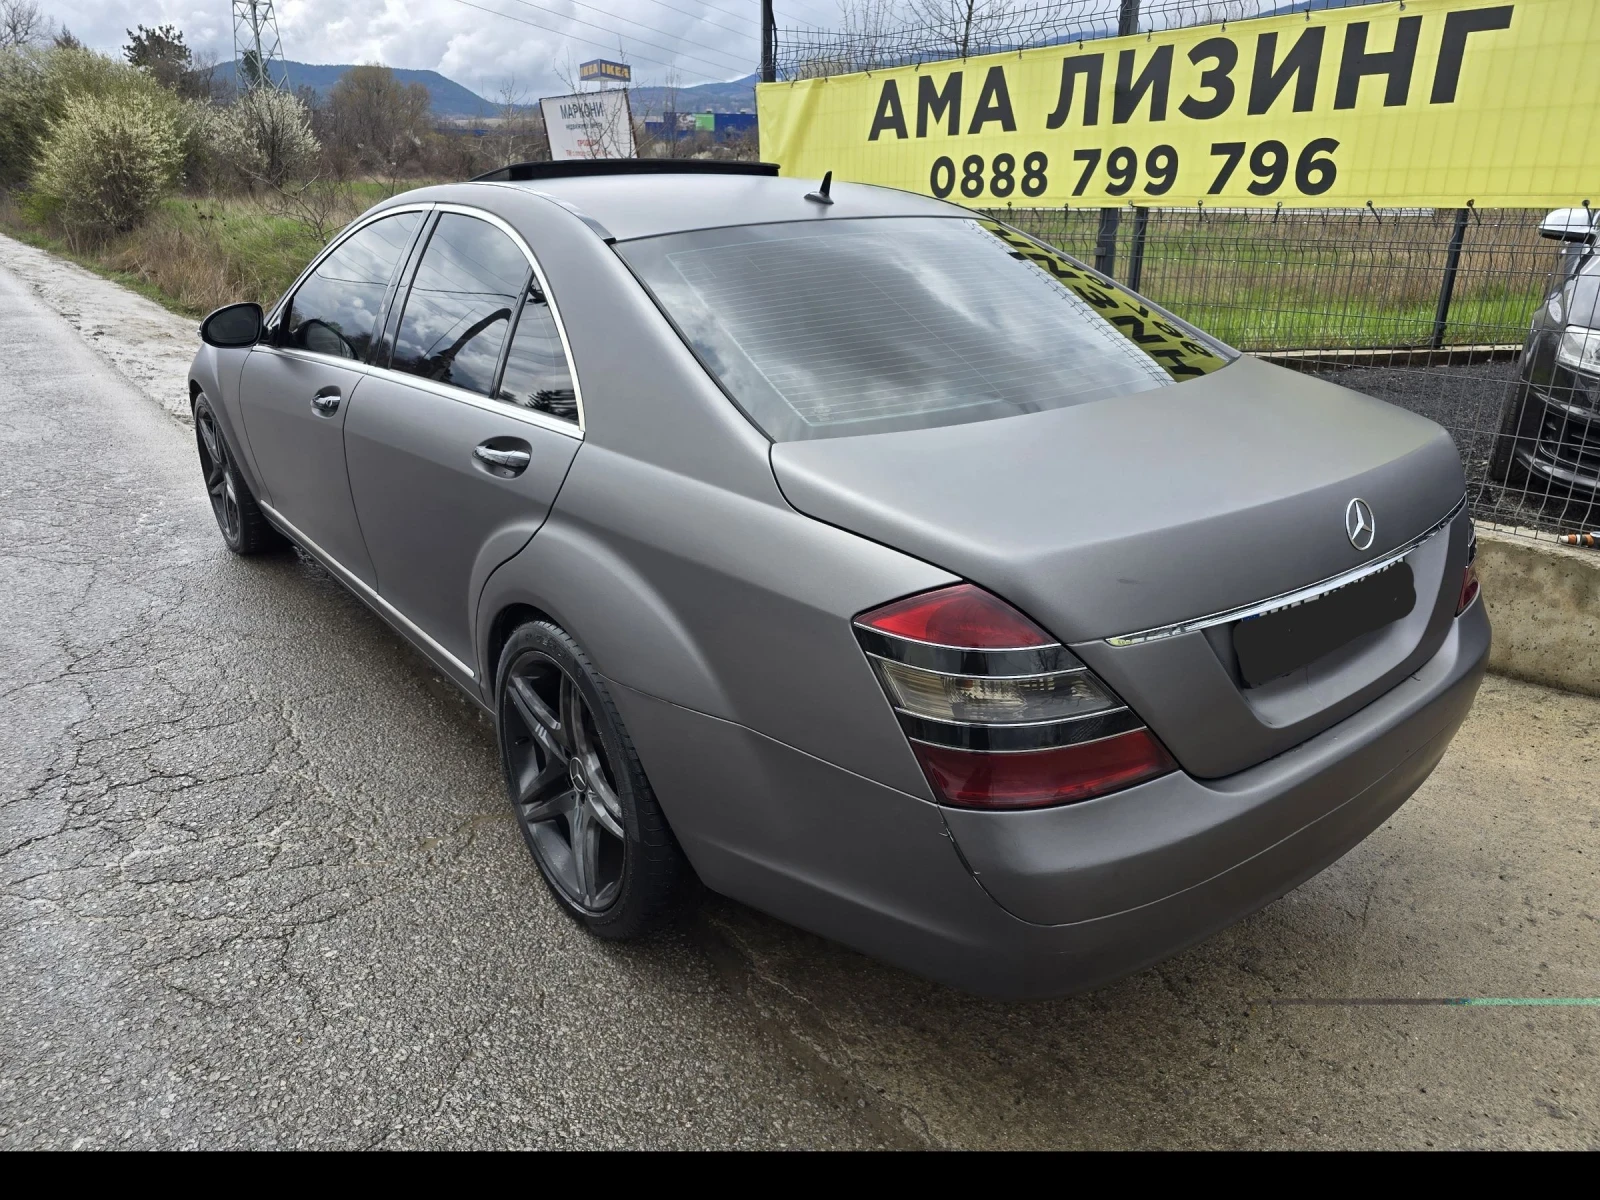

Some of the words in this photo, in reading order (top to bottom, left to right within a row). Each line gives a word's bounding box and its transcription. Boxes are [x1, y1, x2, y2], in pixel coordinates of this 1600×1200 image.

[868, 65, 1017, 141] АМА
[1046, 4, 1515, 130] ЛИЗИНГ
[560, 102, 604, 119] МАРКОНИ
[930, 150, 1048, 199] 0888
[1072, 144, 1179, 197] 799
[1207, 137, 1341, 196] 796
